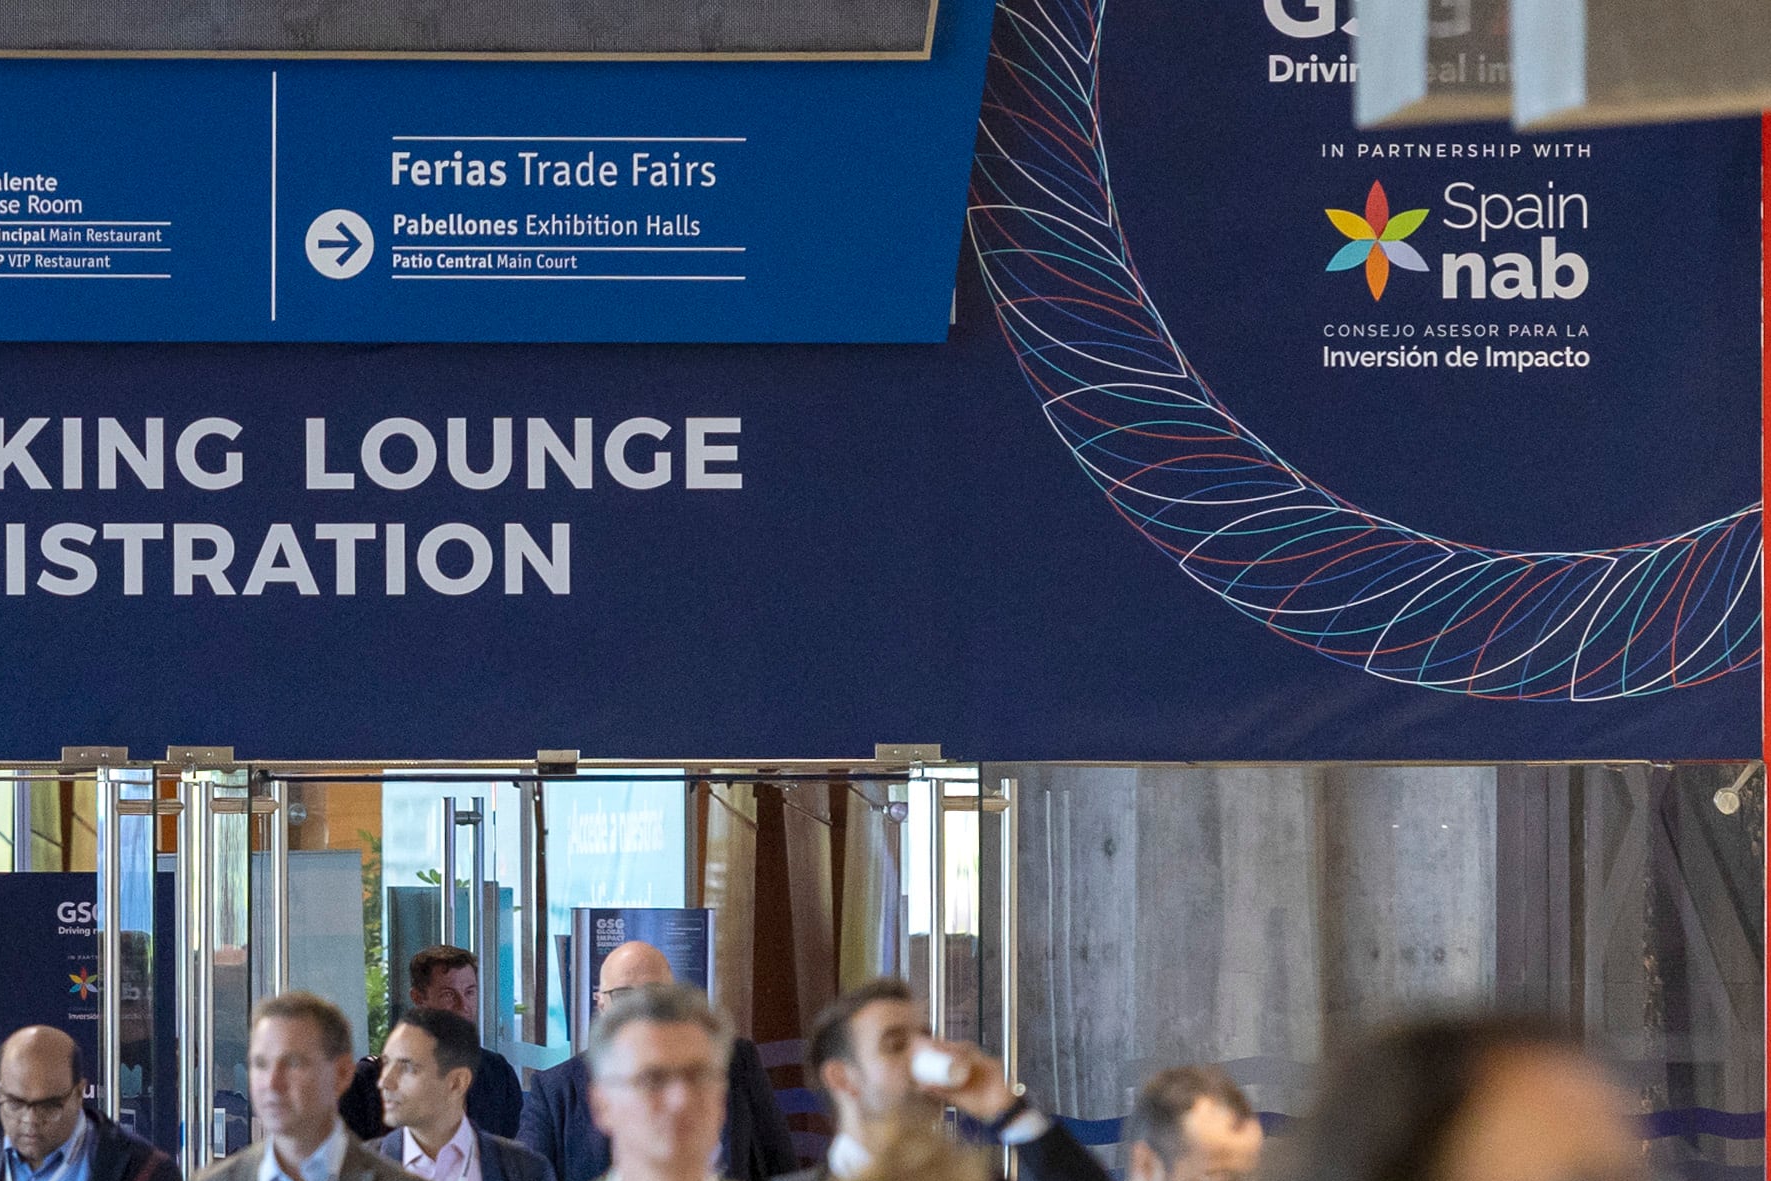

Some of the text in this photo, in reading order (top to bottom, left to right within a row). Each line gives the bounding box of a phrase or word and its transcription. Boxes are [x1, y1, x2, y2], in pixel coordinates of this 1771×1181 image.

[1269, 54, 1358, 84] Drivi
[1321, 143, 1591, 159] IN PARTNERSHIP WITH
[391, 150, 717, 188] Ferias Trade Fairs
[27, 194, 83, 216] Room
[1442, 180, 1589, 241] Spain
[48, 227, 82, 244] Main
[85, 227, 162, 244] Restaurant
[393, 213, 701, 237] Pabellones Exhibition Halls
[7, 253, 32, 269] VIP
[34, 253, 111, 269] Restaurant
[392, 252, 578, 270] Patio Central Main Court
[1441, 236, 1590, 300] nab
[1322, 323, 1590, 339] CONSEJO ASESOR PARA LA
[1323, 345, 1591, 373] Inversión de Impacto
[305, 416, 743, 491] LOUNGE
[58, 926, 91, 937] Driving
[596, 918, 625, 929] GSG
